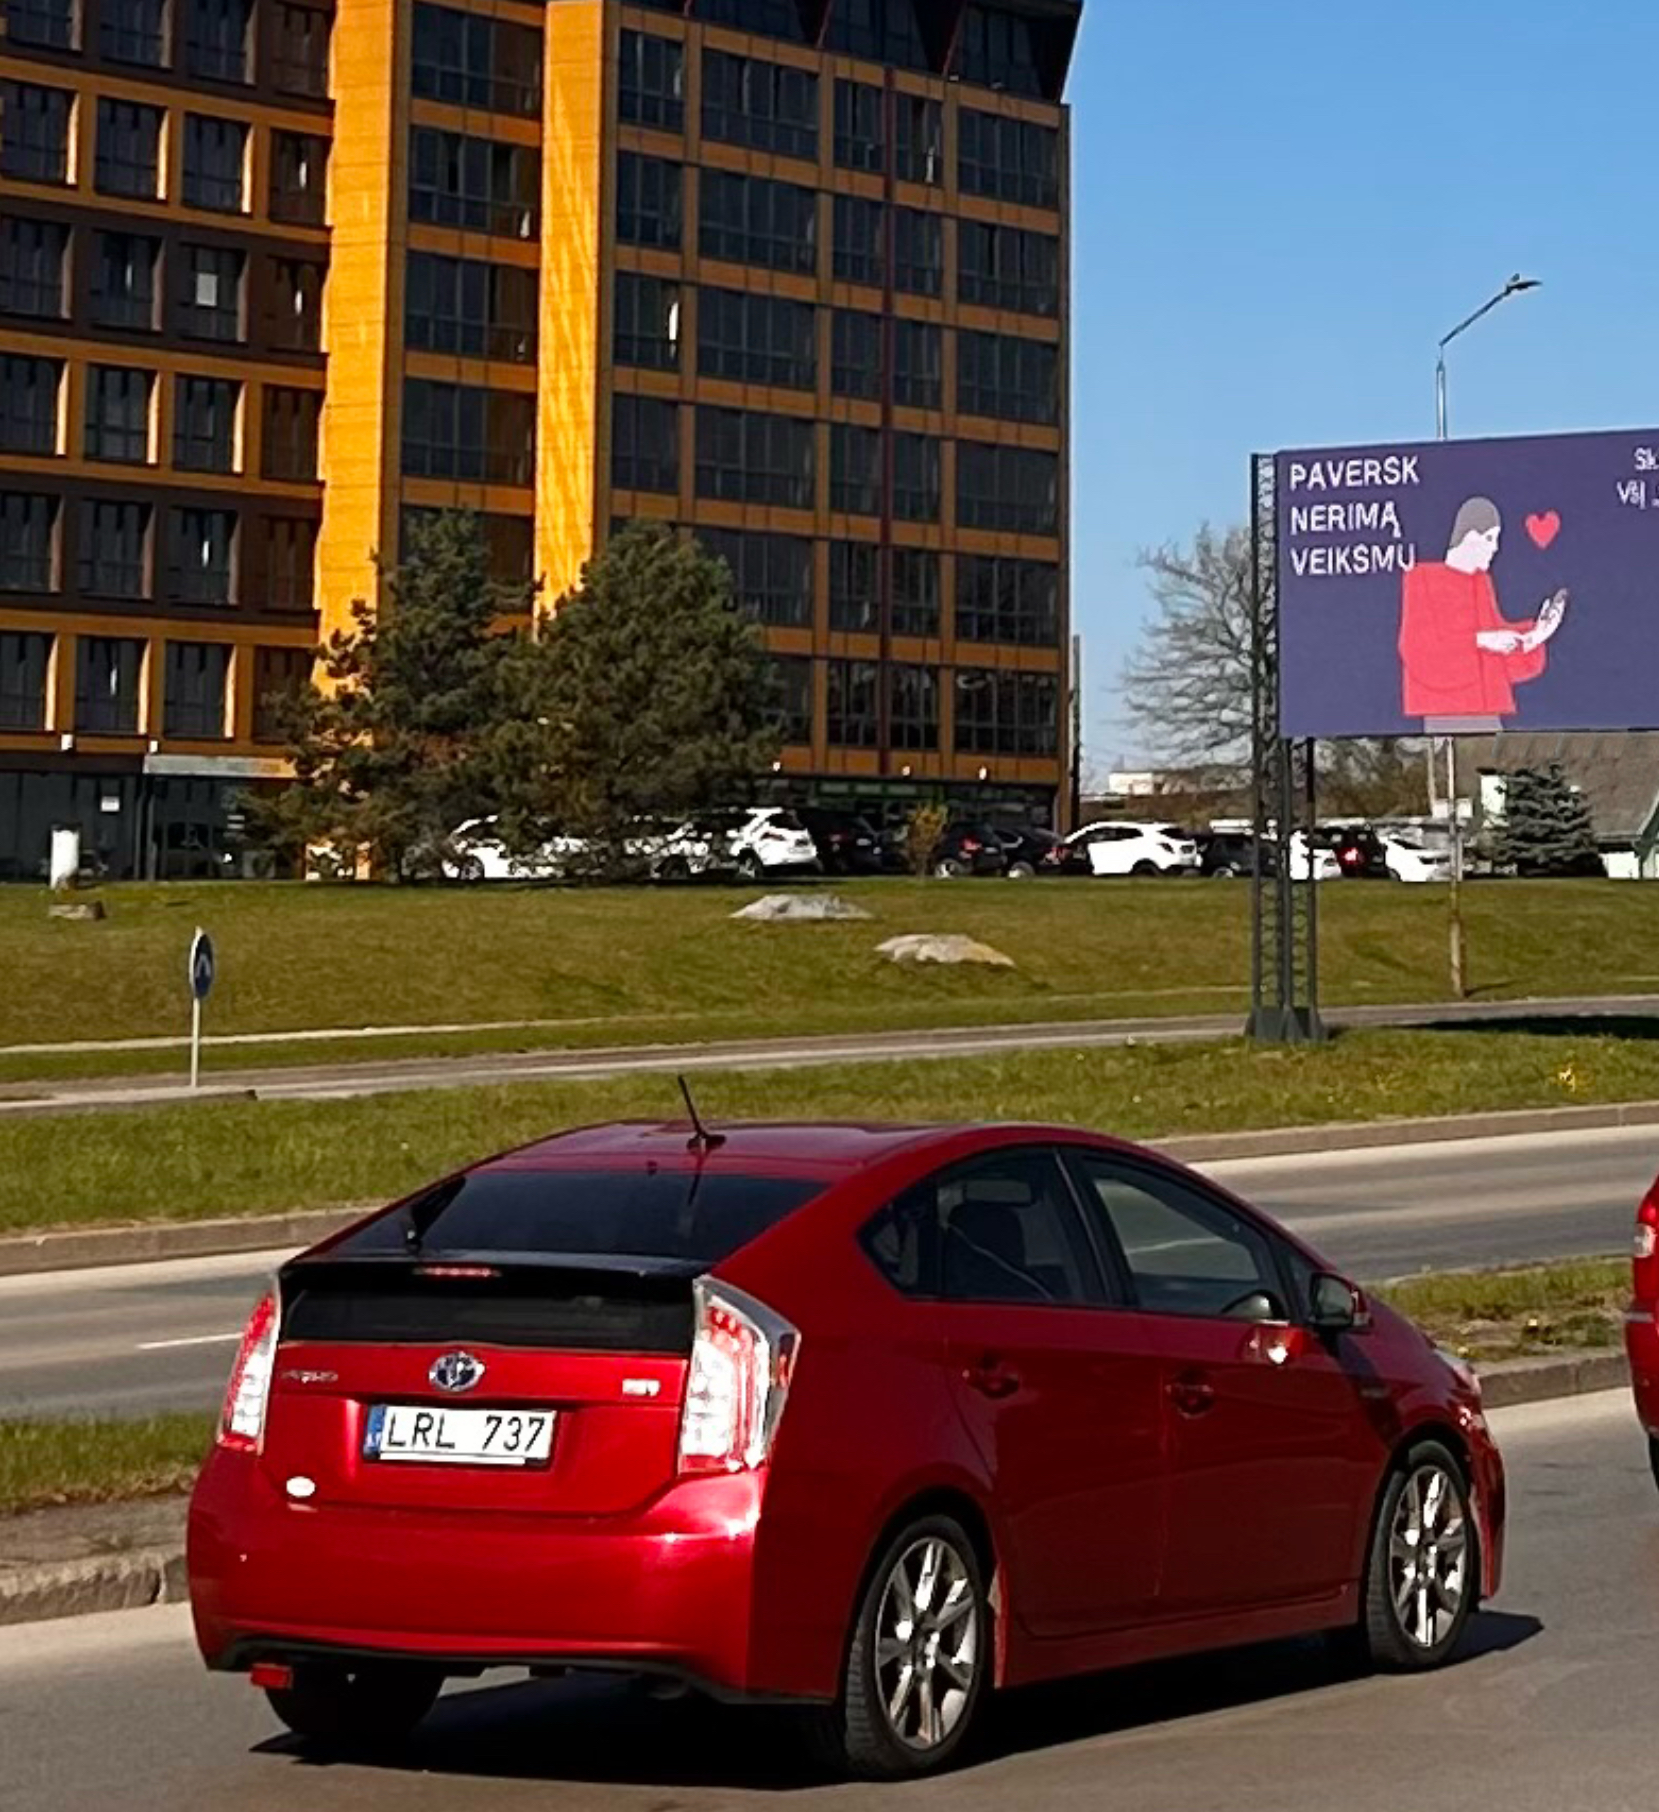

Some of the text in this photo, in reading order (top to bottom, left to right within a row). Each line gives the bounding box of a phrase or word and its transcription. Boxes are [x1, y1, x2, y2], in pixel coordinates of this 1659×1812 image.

[1289, 455, 1419, 491] PAVERSK
[1290, 500, 1402, 538] NERIMĄ
[1289, 543, 1416, 576] VEIKSMU
[387, 1411, 546, 1452] LRL 737
